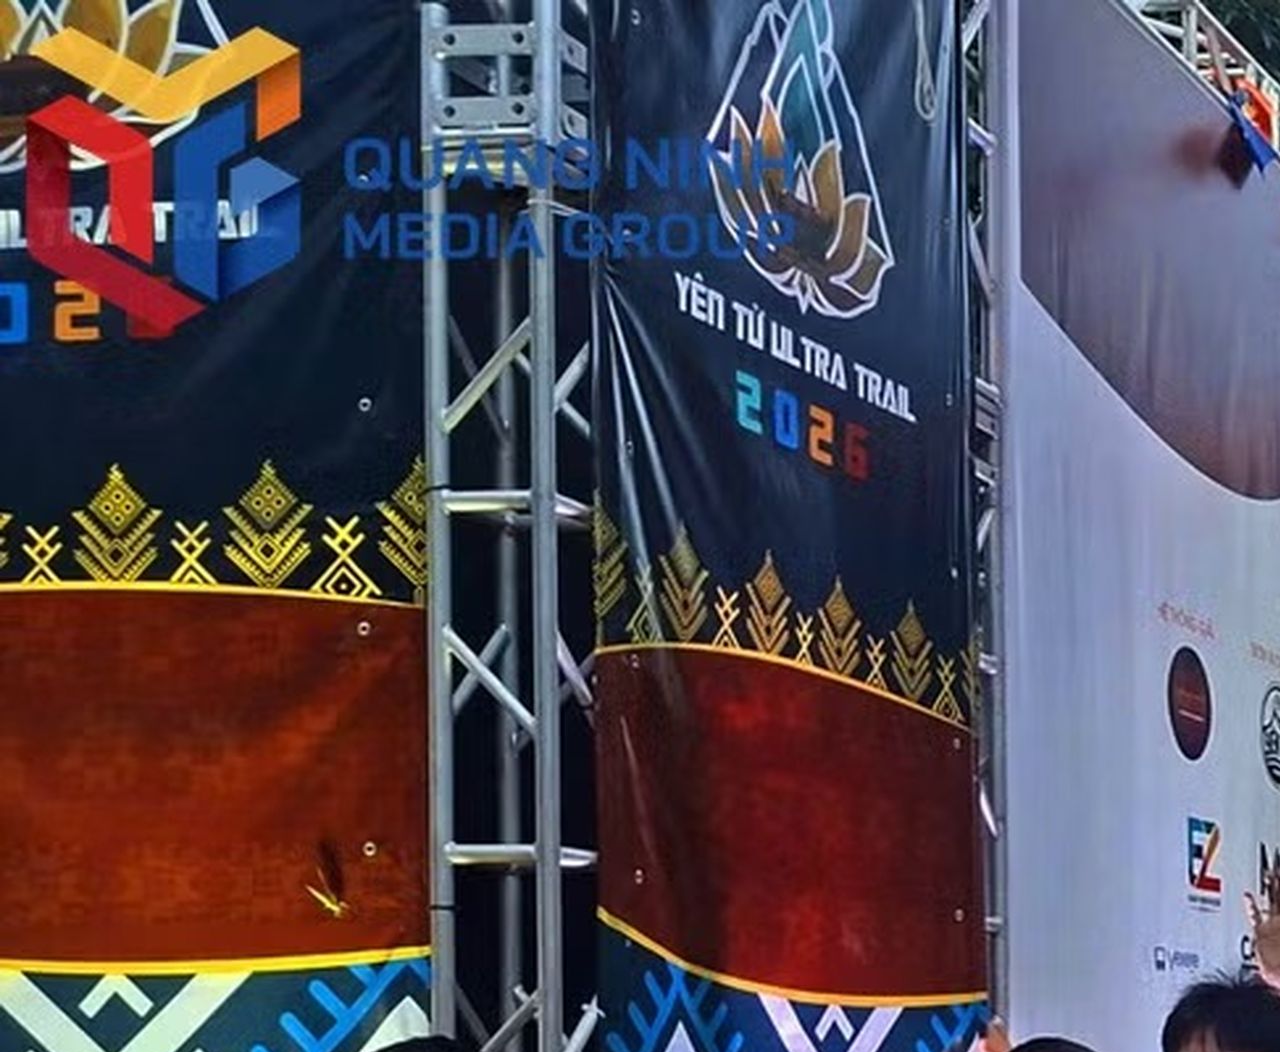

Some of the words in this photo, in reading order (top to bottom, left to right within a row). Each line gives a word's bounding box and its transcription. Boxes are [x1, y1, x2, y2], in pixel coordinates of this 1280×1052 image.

[674, 271, 726, 331] YÊN
[770, 320, 847, 391] ULTRA
[854, 362, 918, 424] TRAIL
[736, 369, 870, 481] 2026
